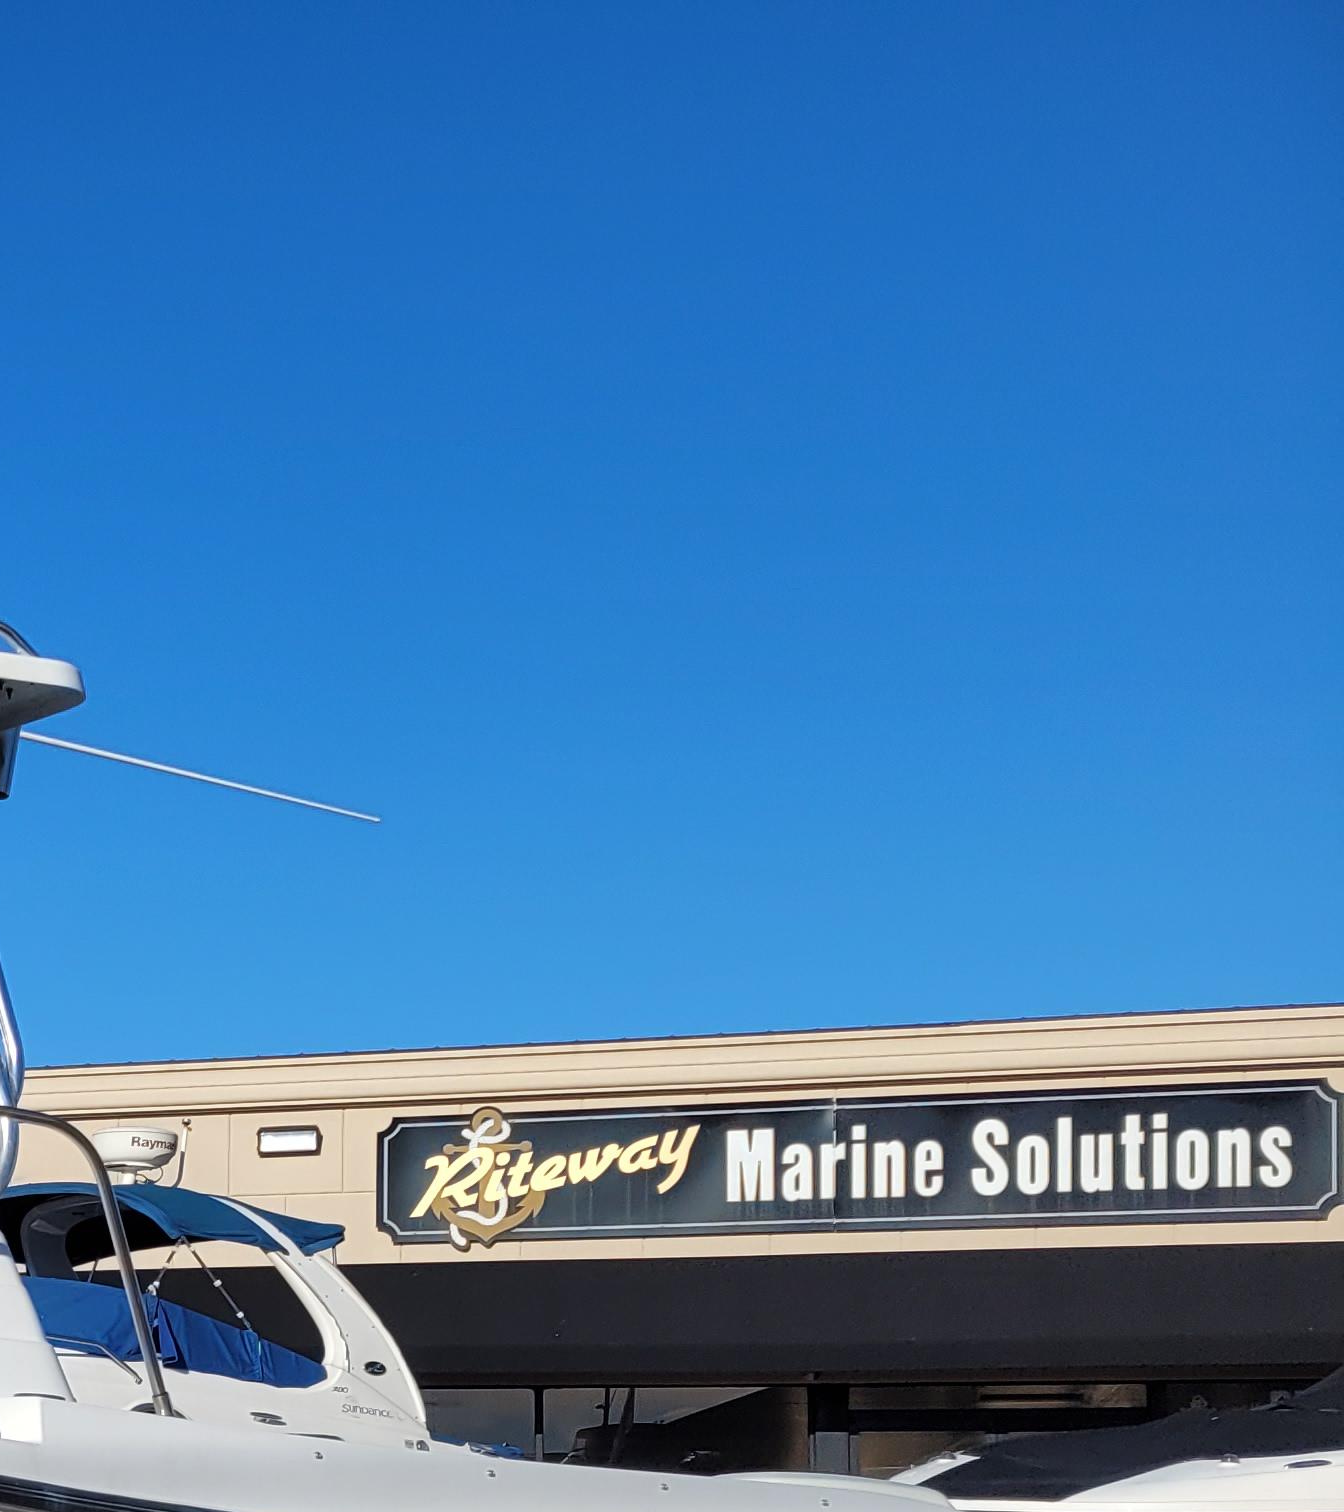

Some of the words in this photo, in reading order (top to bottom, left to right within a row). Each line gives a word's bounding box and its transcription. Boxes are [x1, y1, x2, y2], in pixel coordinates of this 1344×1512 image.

[409, 1124, 701, 1218] Riteway
[725, 1124, 944, 1202] Marine
[972, 1112, 1293, 1198] Solutions
